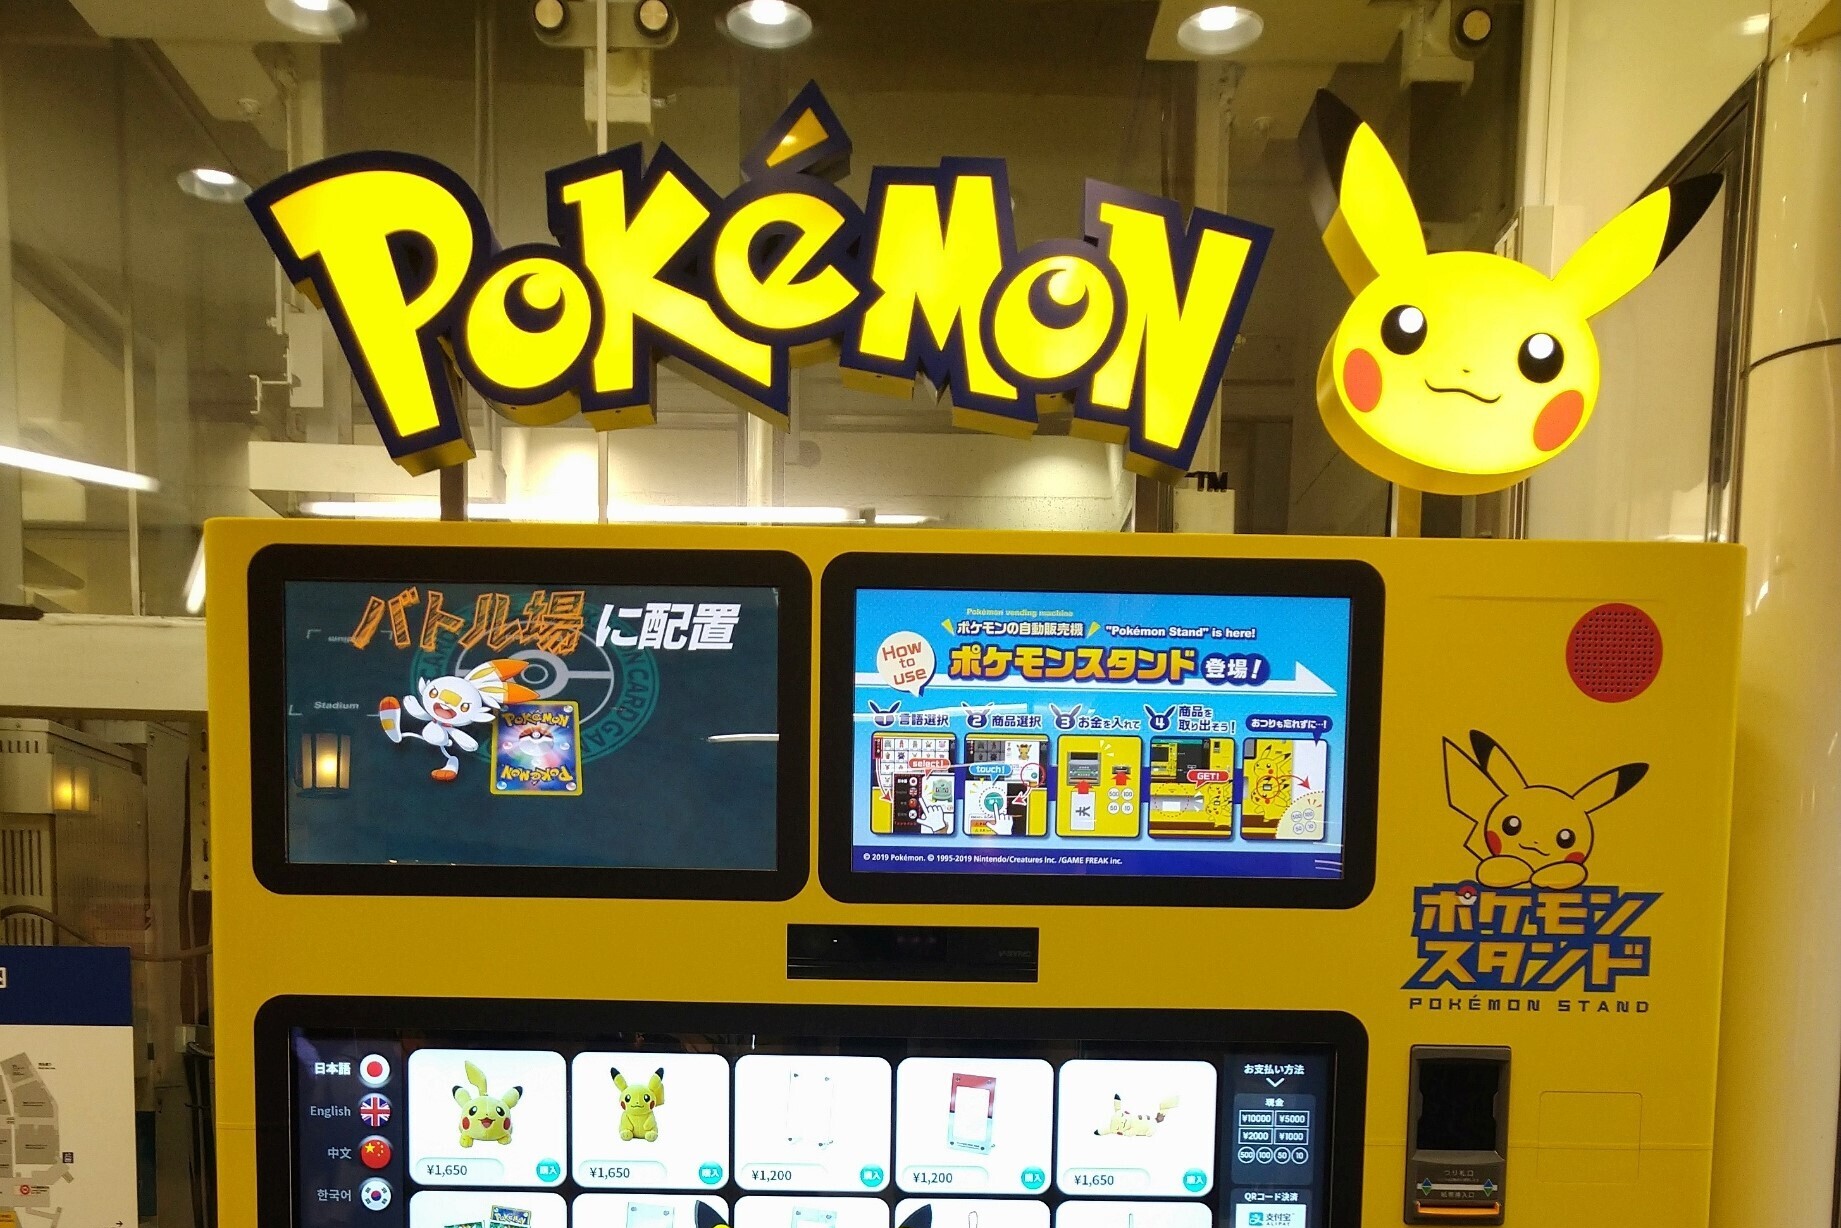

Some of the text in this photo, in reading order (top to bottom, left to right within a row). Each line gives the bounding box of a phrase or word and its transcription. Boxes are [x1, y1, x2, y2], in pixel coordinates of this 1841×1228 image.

[966, 608, 1073, 618] Pokémon vending machine
[957, 621, 1083, 636] ポケモンの自動販売機
[1212, 627, 1222, 637] is
[1226, 628, 1256, 638] here!
[882, 641, 922, 661] How
[900, 656, 916, 668] to
[951, 645, 1195, 681] ポケモンスタンド
[894, 668, 927, 685] use
[314, 701, 359, 710] Stadium
[1179, 706, 1212, 718] 商品を
[899, 714, 949, 726] 言語選択
[972, 715, 1041, 728] 2 商品選択
[1061, 716, 1140, 729] 3 お金を入れて
[1155, 717, 1165, 728] 4
[912, 760, 944, 769] select!
[976, 765, 1005, 774] touch!
[1197, 772, 1220, 780] GET!
[872, 853, 889, 861] 2019
[891, 853, 926, 862] Pokémon.
[937, 854, 972, 862] 1995-2019
[974, 855, 1043, 864] Nintendo/Creatures
[1058, 857, 1084, 865] /GAME
[1086, 857, 1108, 865] FREAK
[1413, 884, 1658, 937] ポケモン
[1407, 938, 1649, 989] スタンド
[1409, 995, 1649, 1013] POKÉMON STAND
[314, 1062, 351, 1075] 日本語
[1244, 1064, 1305, 1075] お支払い方法
[1265, 1098, 1285, 1107] 現金
[310, 1106, 351, 1118] English
[1242, 1114, 1306, 1124] ¥10000 ¥5000
[1242, 1131, 1304, 1141] ¥2000 ¥1000
[328, 1147, 351, 1160] 中文
[1240, 1151, 1304, 1160] 500 100 50 10
[427, 1164, 467, 1177] ¥1,650
[590, 1167, 630, 1179] ¥1,650
[751, 1169, 792, 1182] ¥1,200
[913, 1172, 953, 1184] ¥1,200
[1074, 1174, 1114, 1187] ¥1,650
[317, 1189, 351, 1202] 한국어
[1244, 1192, 1298, 1202] QRコード決済
[1266, 1212, 1292, 1222] 支付宝
